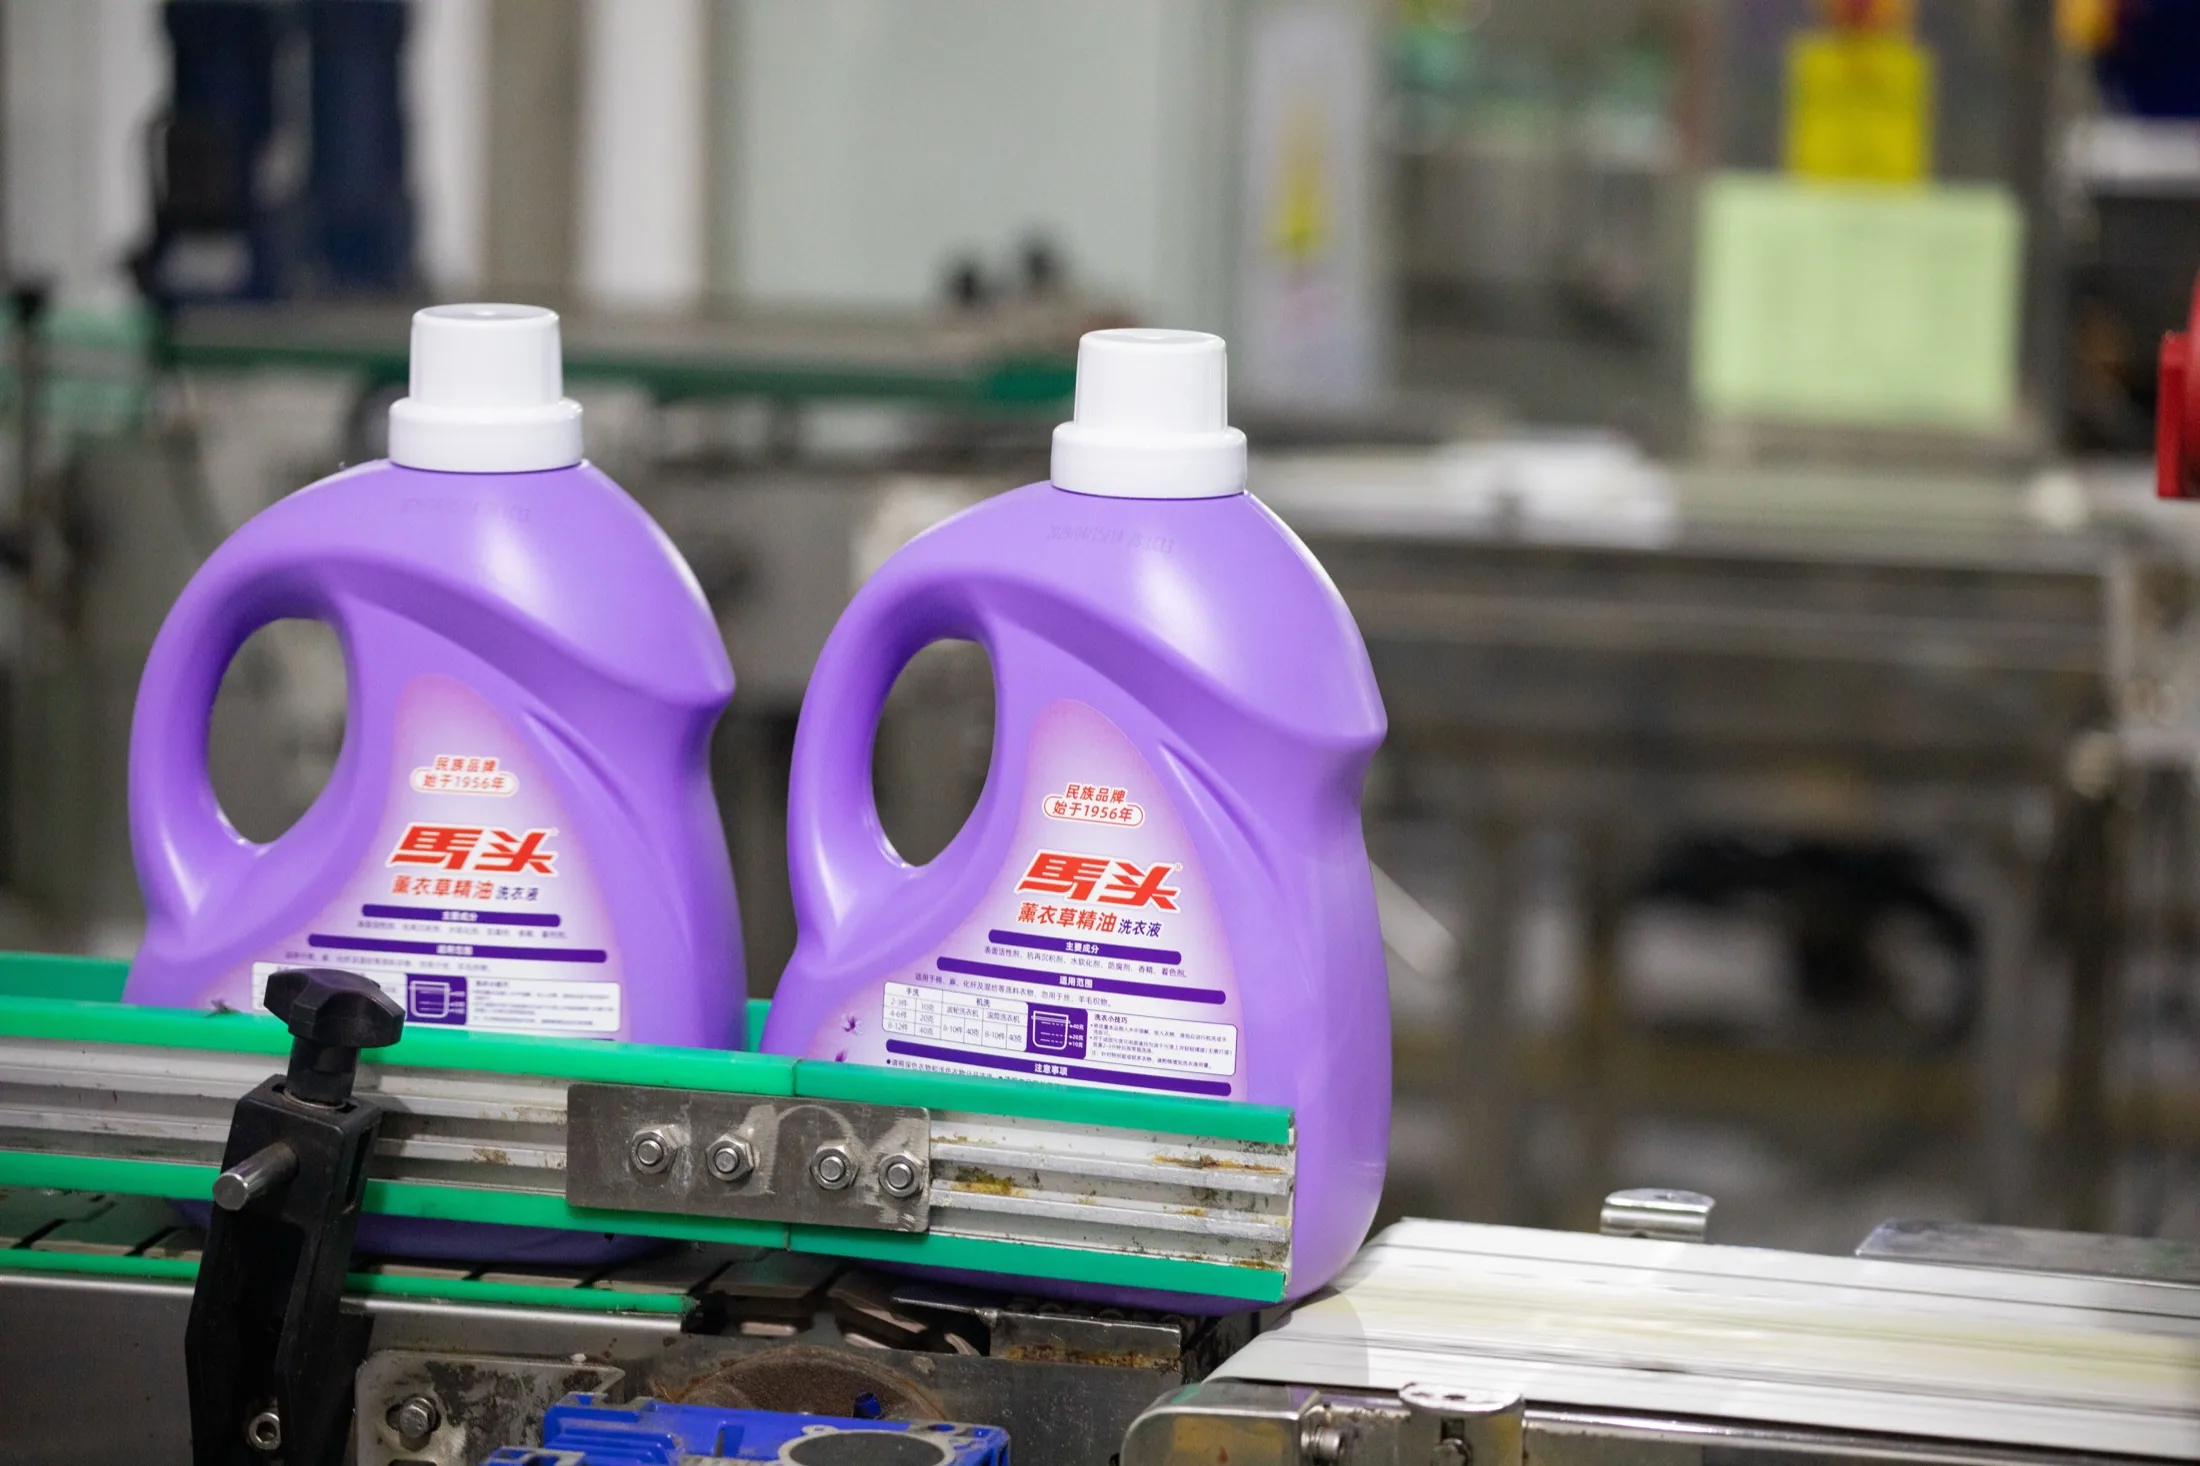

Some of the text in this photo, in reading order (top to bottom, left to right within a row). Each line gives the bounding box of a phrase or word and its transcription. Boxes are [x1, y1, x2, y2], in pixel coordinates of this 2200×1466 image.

[435, 757, 496, 772] 民族品牌
[423, 774, 505, 790] 始于1956年
[1066, 784, 1126, 804] 民族品牌
[1052, 801, 1133, 822] 始于1956年
[391, 875, 495, 900] 薰衣草精油
[1017, 902, 1162, 937] 薰衣草精油 洗衣液
[1065, 941, 1099, 954] 主要成分
[1059, 975, 1093, 988] 适用范围
[1034, 1063, 1068, 1076] 注意事项
